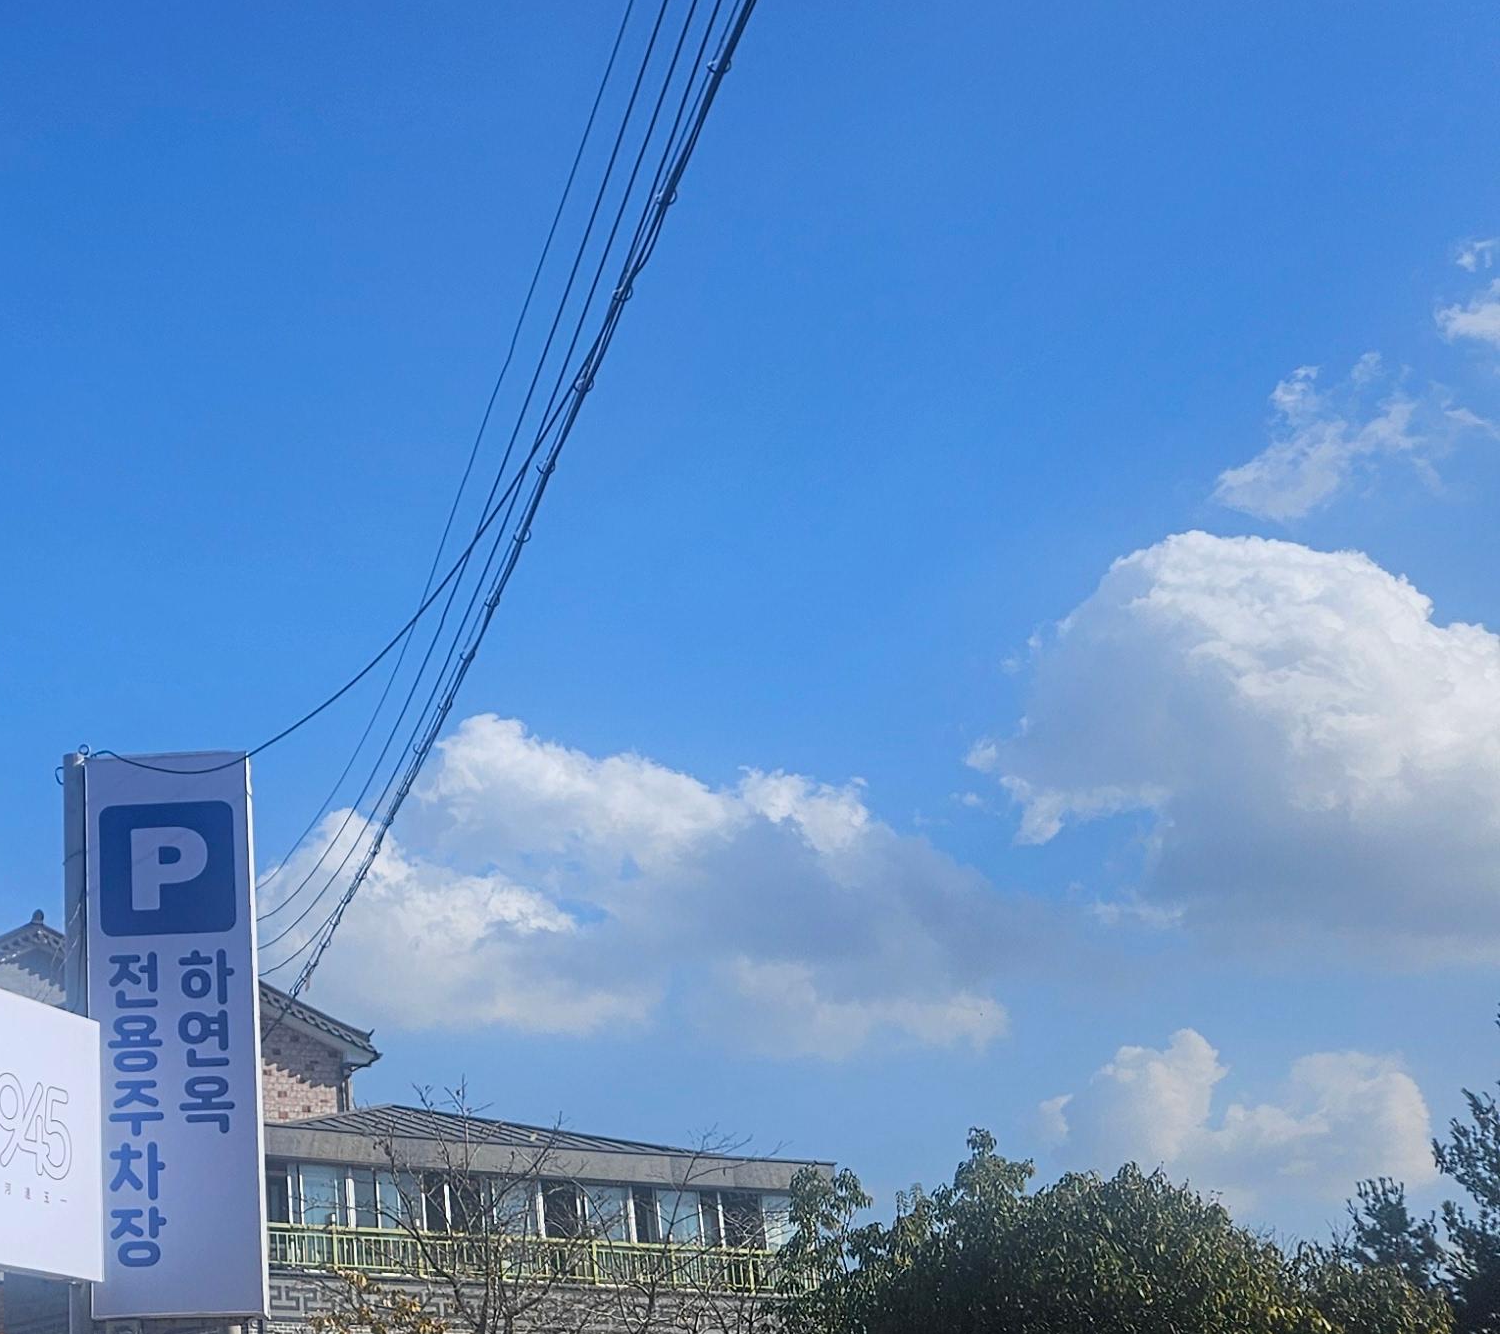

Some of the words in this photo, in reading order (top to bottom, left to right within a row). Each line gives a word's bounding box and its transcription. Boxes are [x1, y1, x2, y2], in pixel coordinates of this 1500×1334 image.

[130, 826, 208, 911] P
[107, 951, 167, 1268] 전용주차장
[177, 949, 236, 1134] 하연옥
